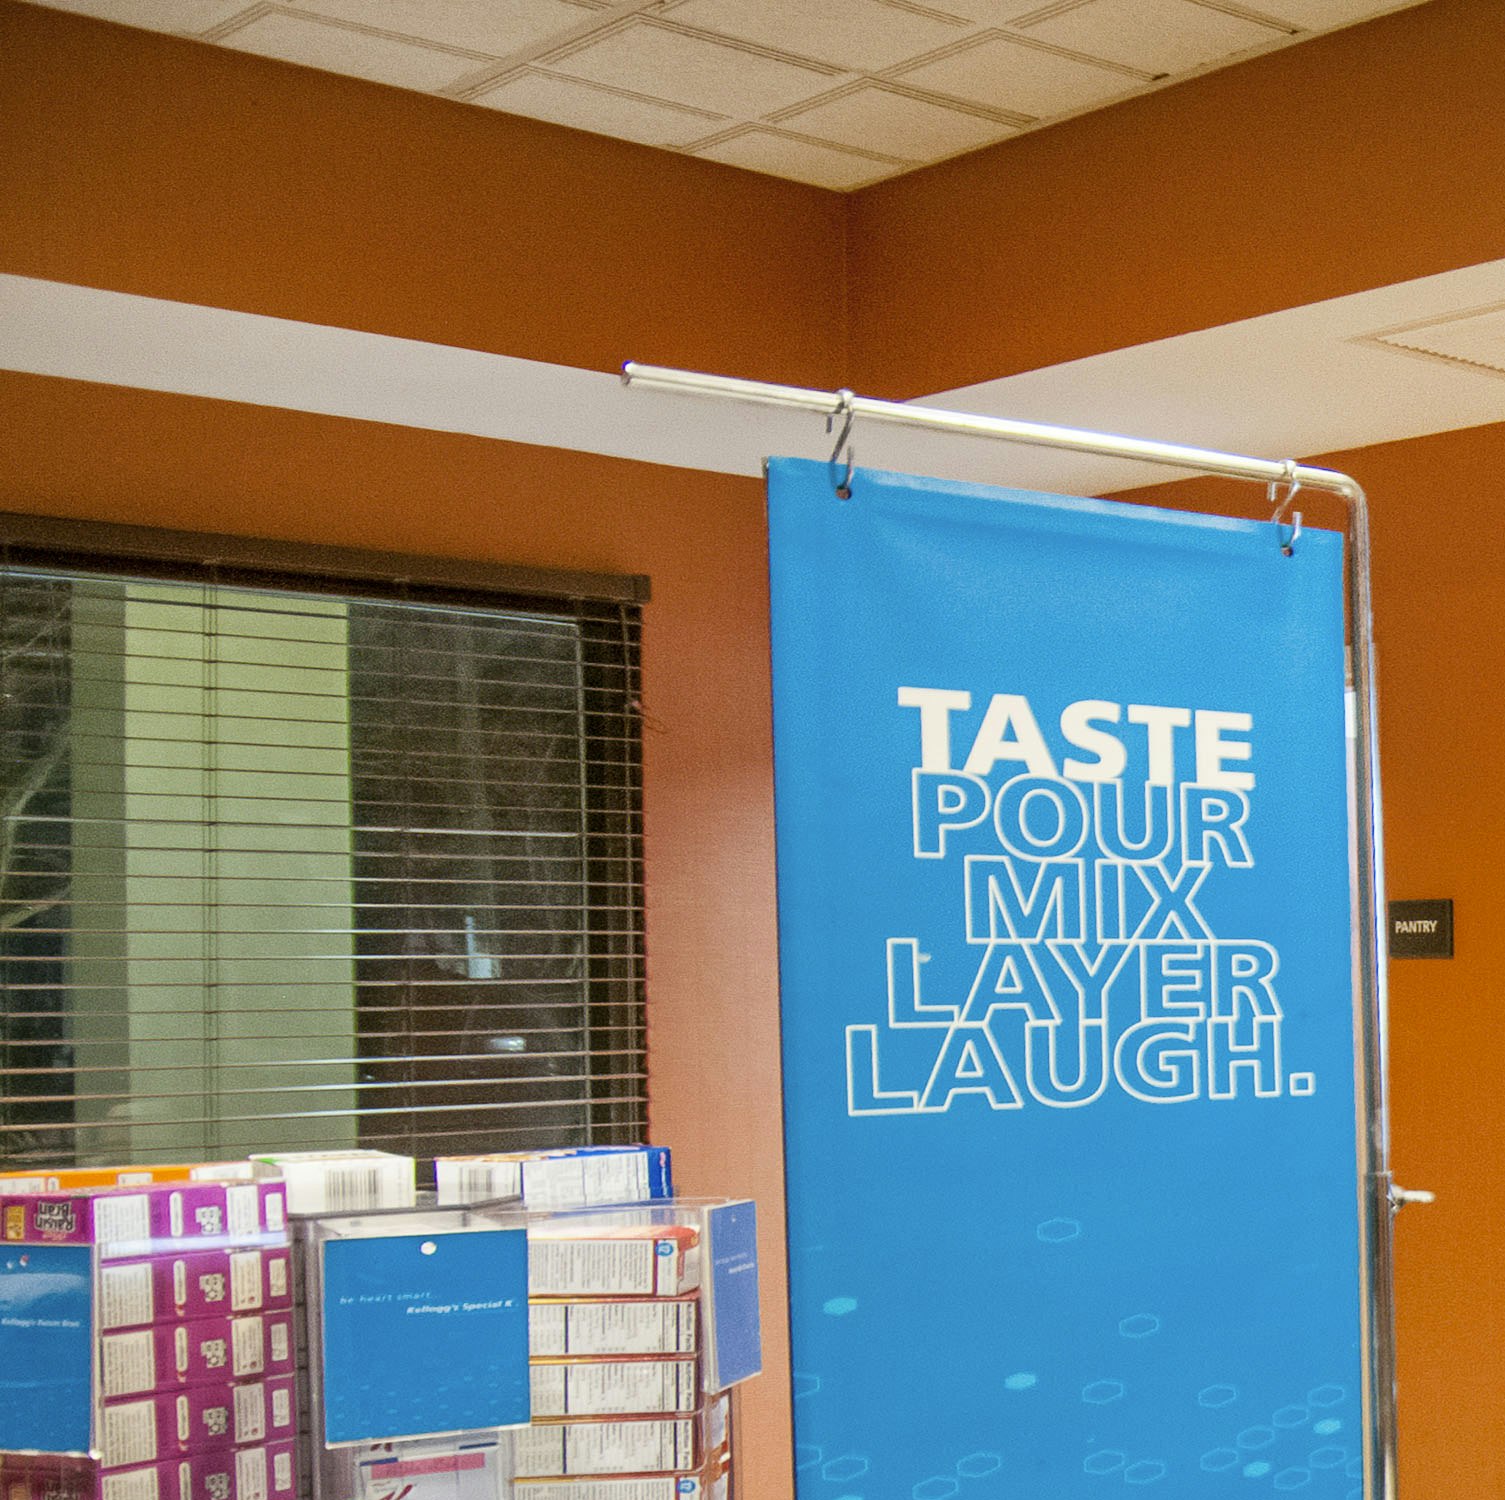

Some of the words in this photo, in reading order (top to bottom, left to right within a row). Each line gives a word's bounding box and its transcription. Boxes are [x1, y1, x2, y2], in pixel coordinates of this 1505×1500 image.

[897, 686, 1255, 791] TASTE
[911, 766, 1254, 868] POUR
[964, 855, 1214, 945] MIX
[1394, 920, 1438, 934] PANTRY
[886, 937, 1284, 1029] LAYER
[845, 1019, 1316, 1116] LAUGH.
[462, 1300, 502, 1312] Special
